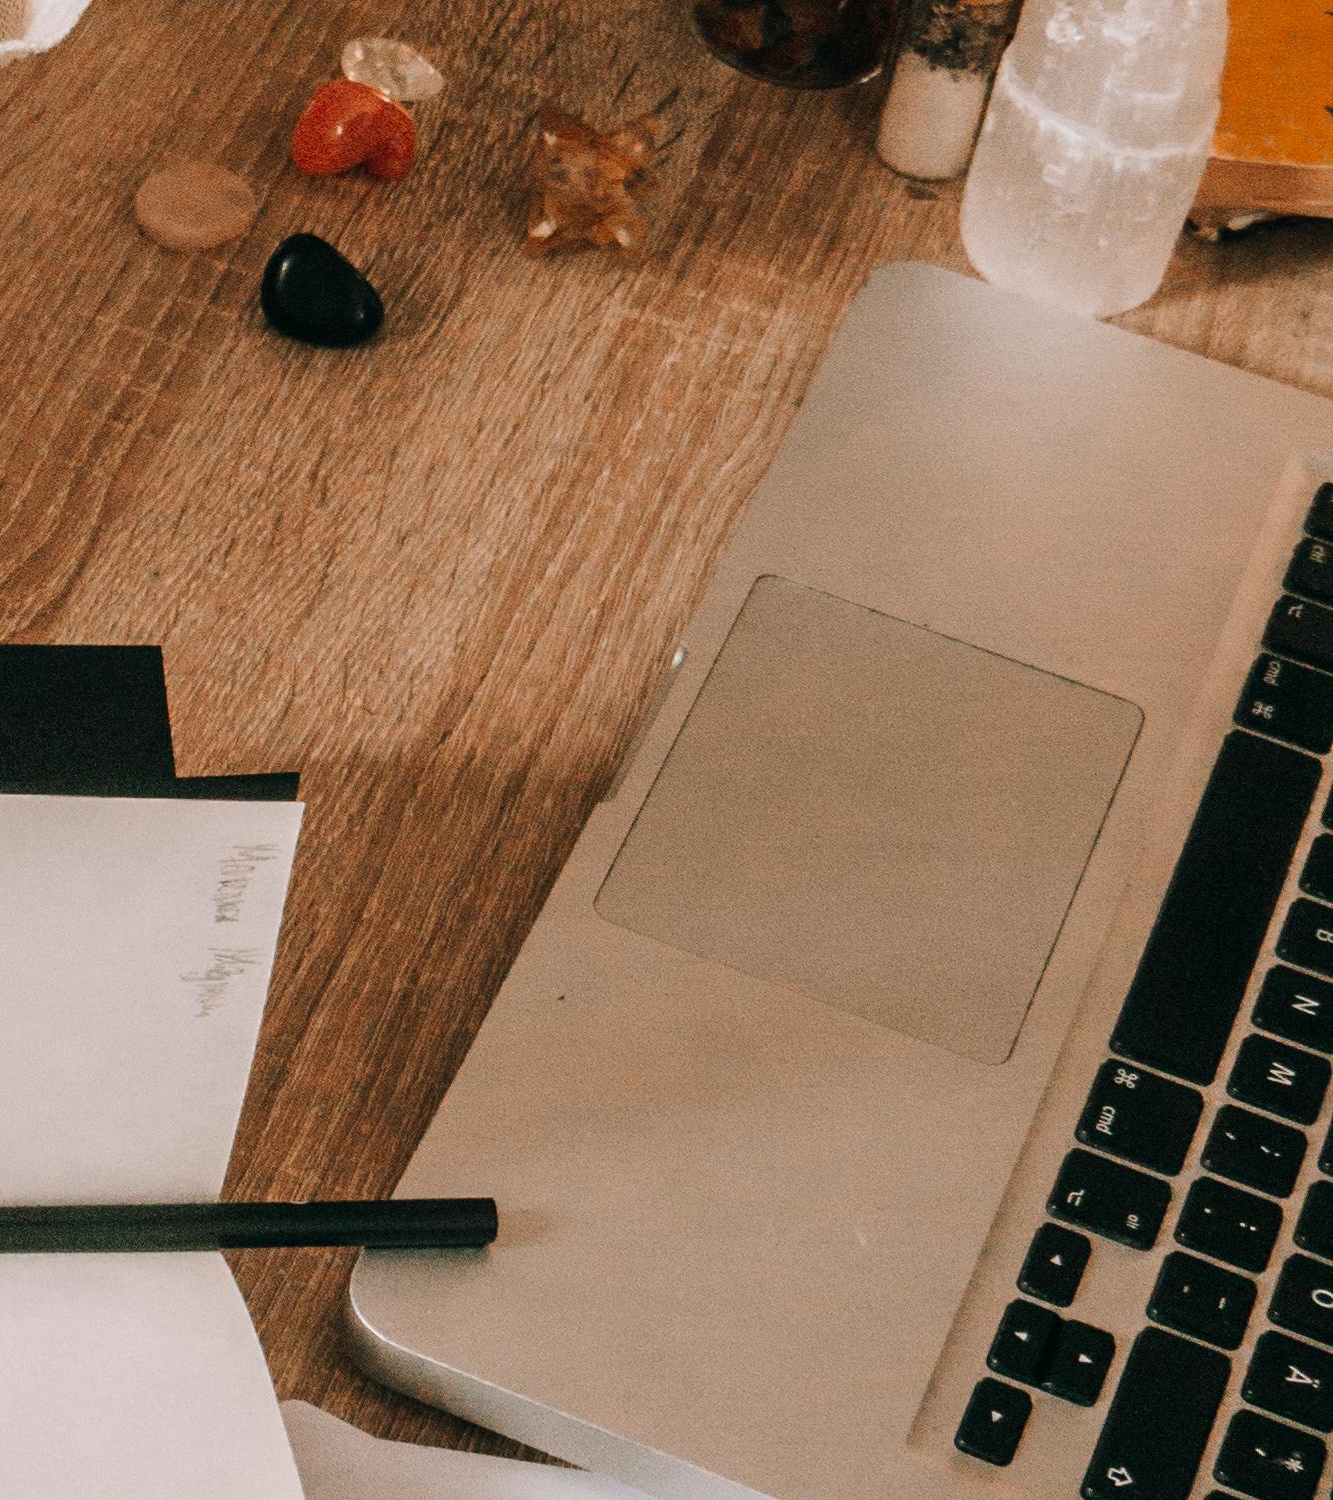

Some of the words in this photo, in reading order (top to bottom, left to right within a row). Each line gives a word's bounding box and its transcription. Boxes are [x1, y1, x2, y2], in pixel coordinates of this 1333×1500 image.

[1263, 659, 1282, 687] cmd
[1291, 994, 1321, 1016] N
[1266, 1061, 1296, 1086] M
[1096, 1105, 1117, 1136] cmd
[1284, 1364, 1321, 1390] Ä
